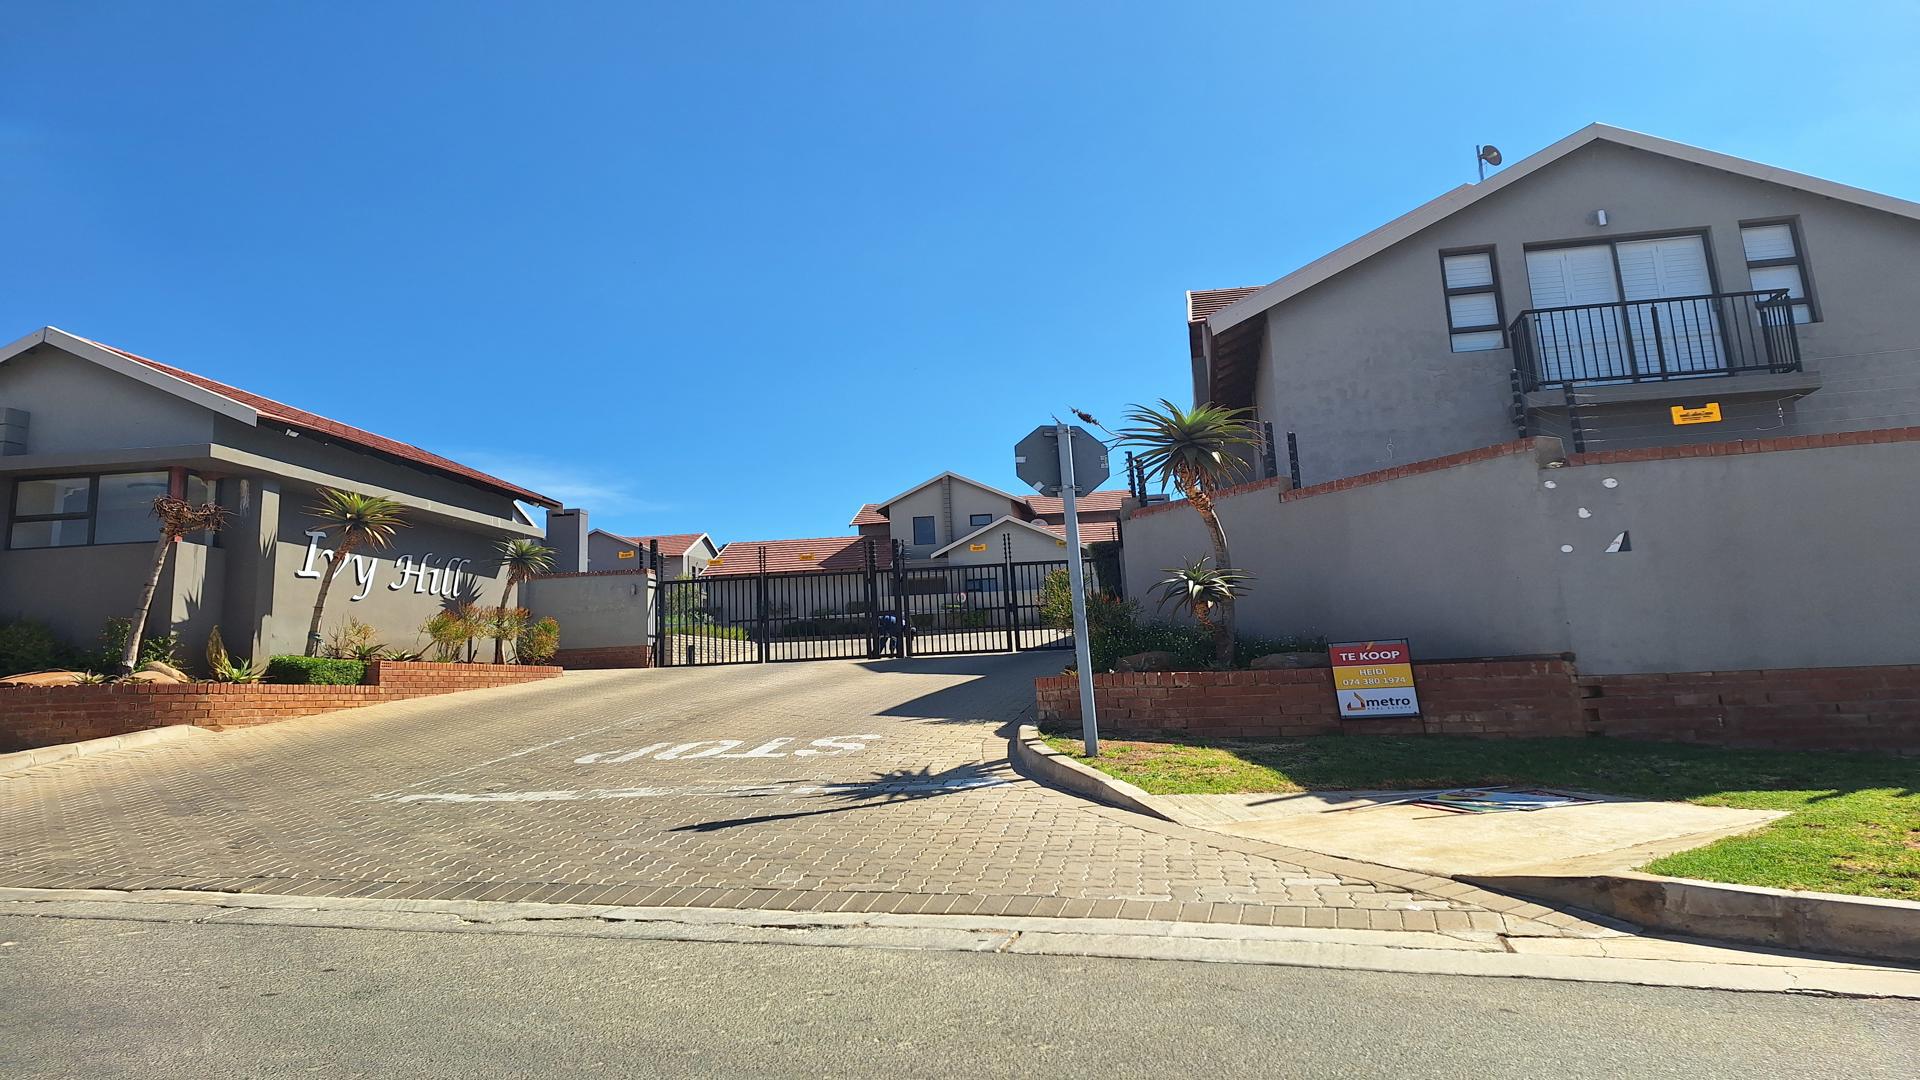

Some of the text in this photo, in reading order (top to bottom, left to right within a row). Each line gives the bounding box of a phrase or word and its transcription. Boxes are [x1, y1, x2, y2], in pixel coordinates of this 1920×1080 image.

[296, 529, 471, 601] Ivy Hill
[1339, 650, 1400, 661] TE KOOP
[1359, 668, 1386, 676] HEIDI
[1384, 676, 1406, 684] 1974
[1366, 697, 1410, 706] metro
[573, 733, 881, 764] STOP
